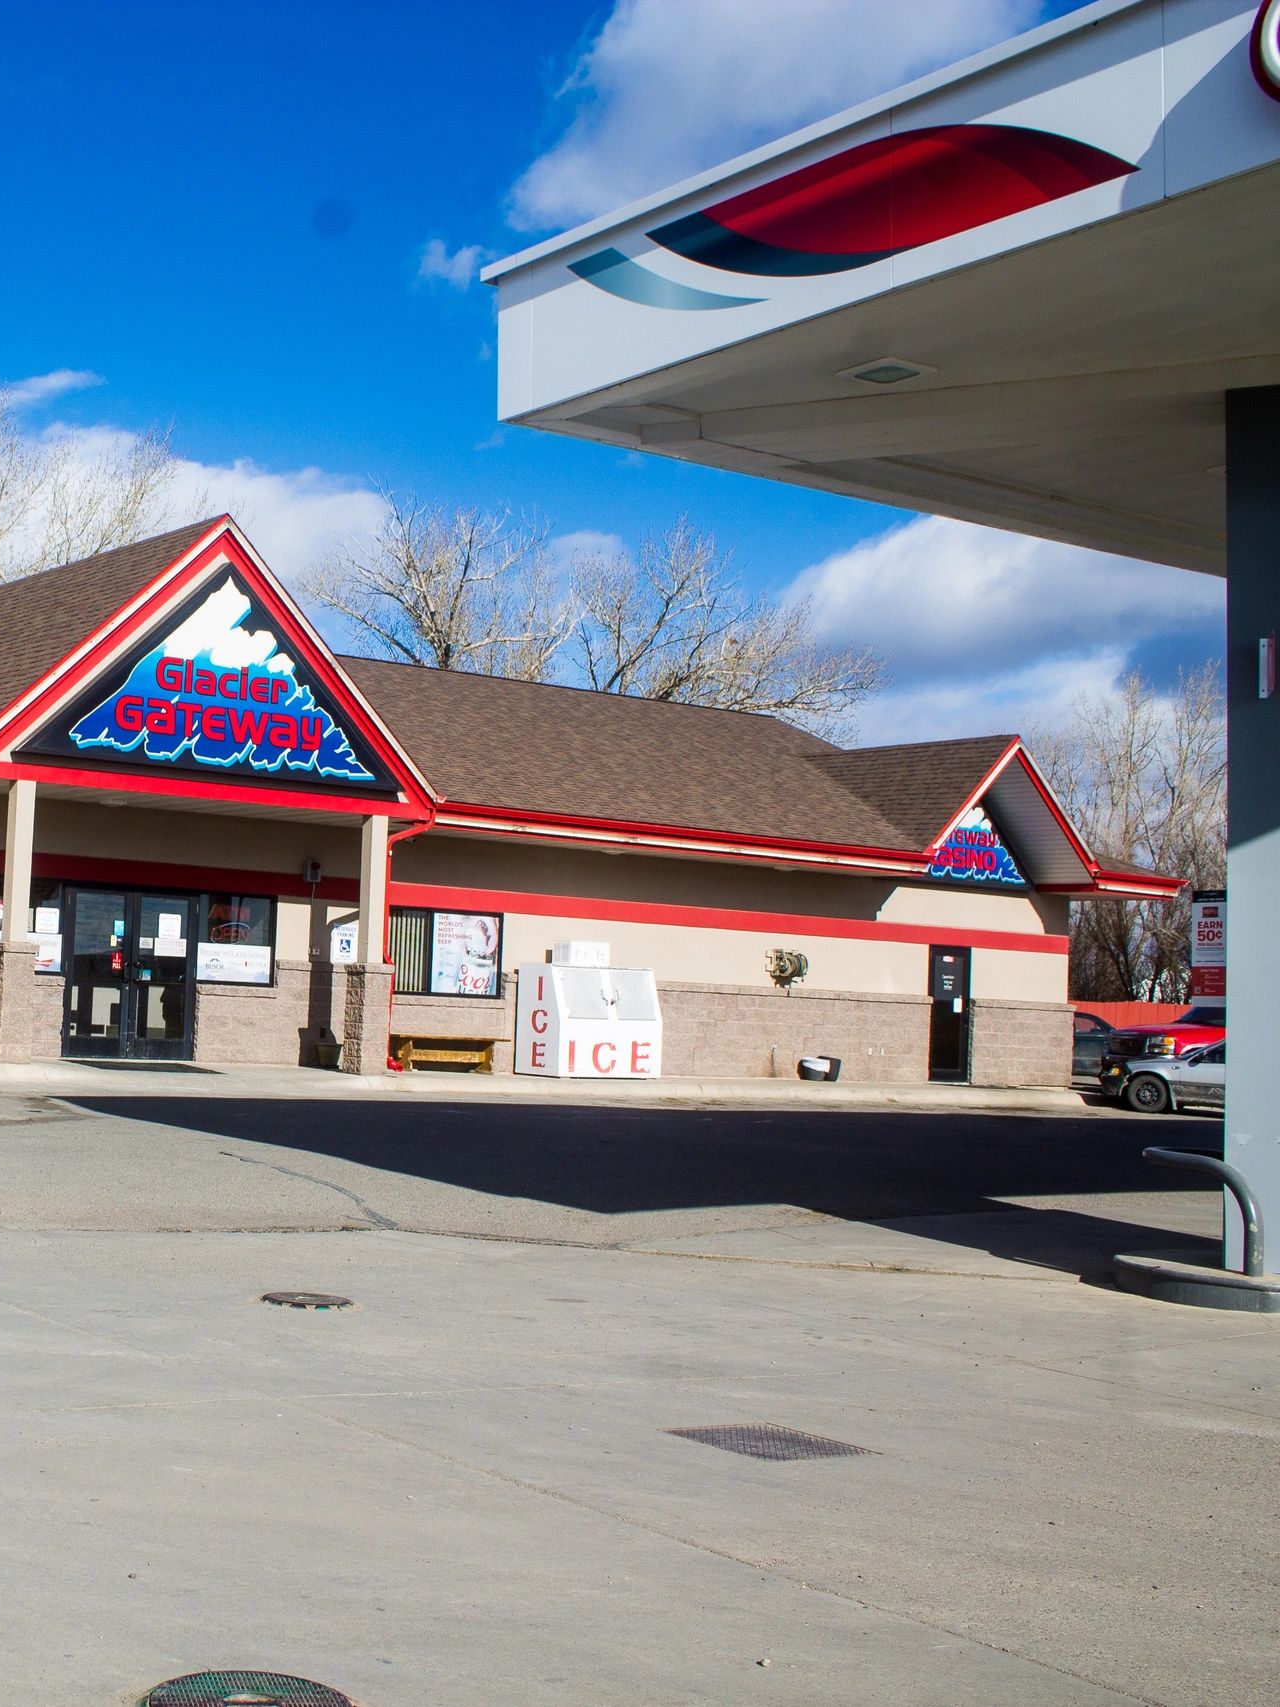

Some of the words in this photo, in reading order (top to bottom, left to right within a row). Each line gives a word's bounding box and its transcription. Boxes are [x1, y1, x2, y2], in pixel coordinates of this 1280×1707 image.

[155, 656, 289, 705] Glacier
[1197, 921, 1223, 930] EARN
[437, 932, 473, 941] REFRESHING
[1197, 930, 1223, 942] 50¢
[205, 962, 224, 970] BUSCH
[531, 976, 548, 1068] ICE
[568, 1040, 652, 1074] ICE
